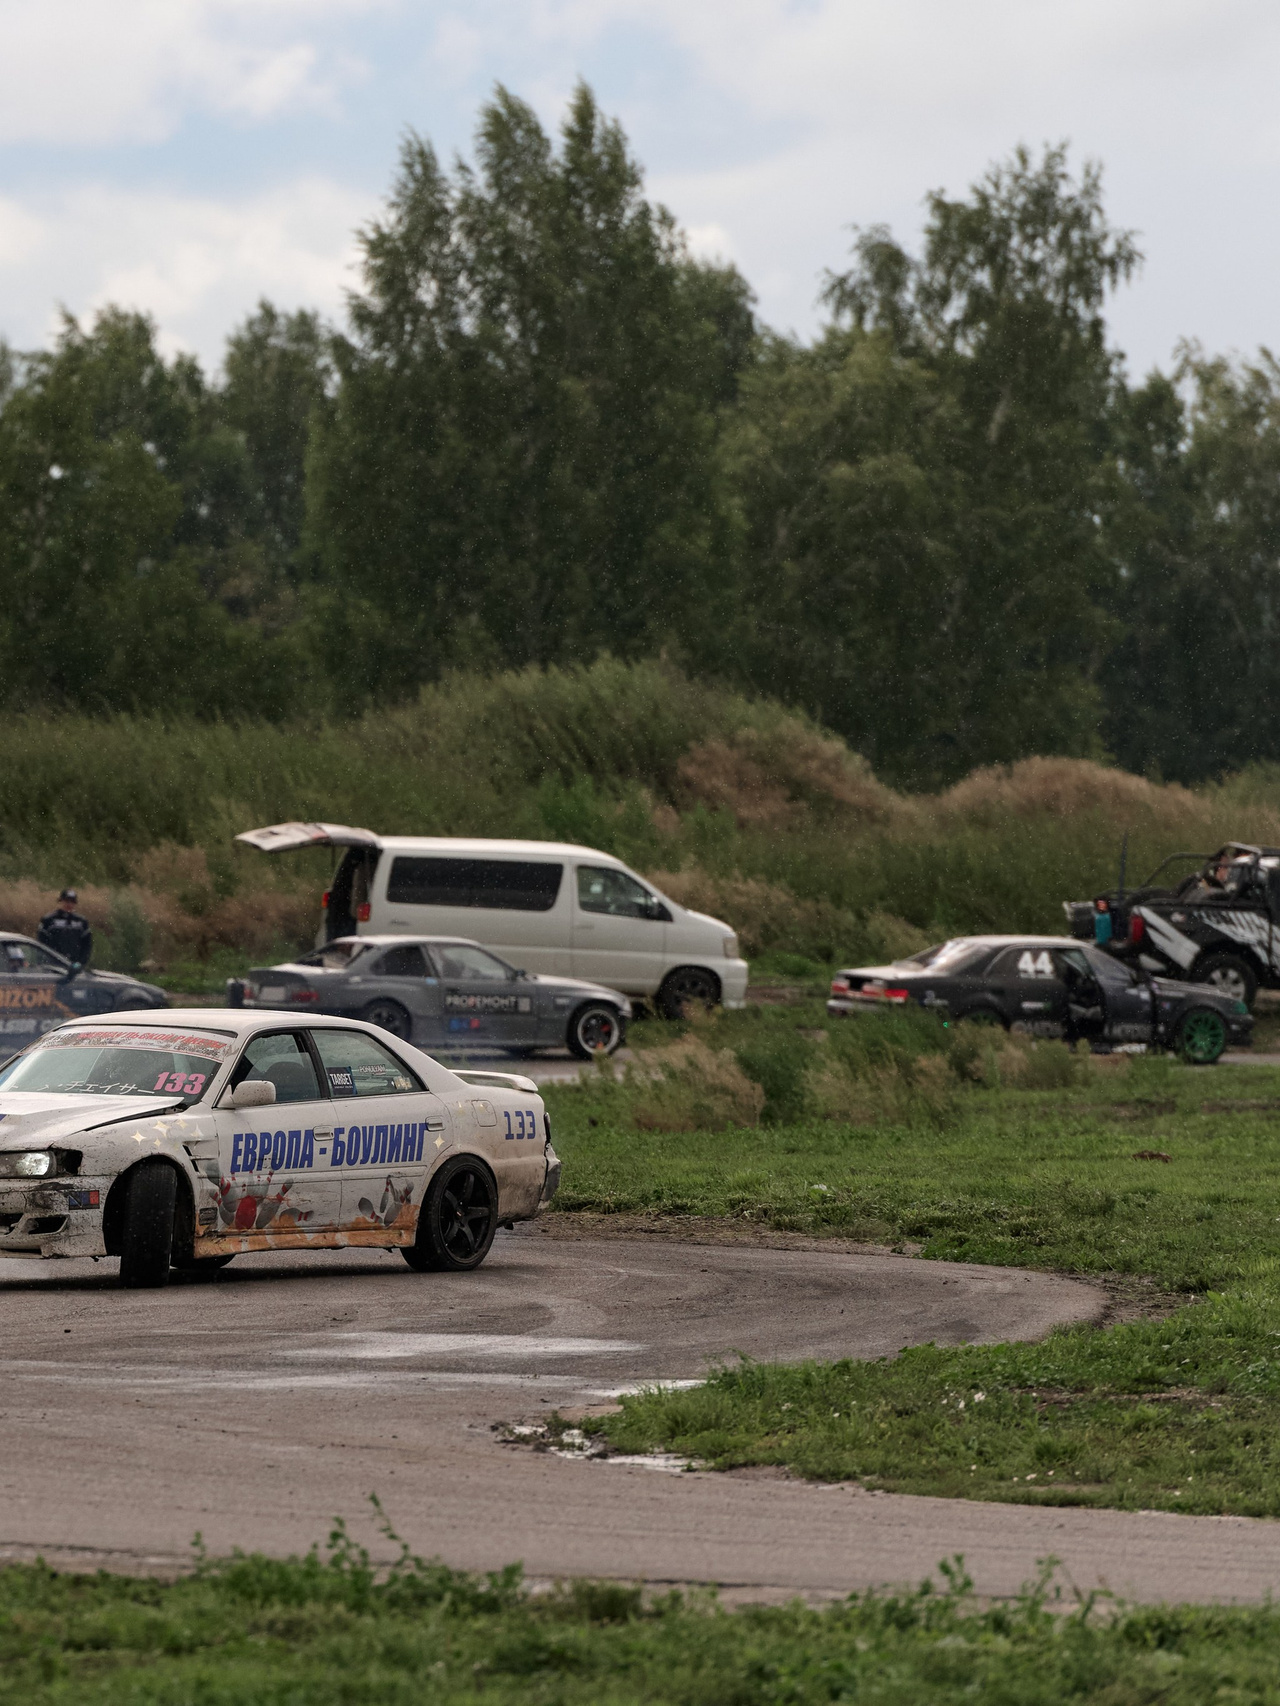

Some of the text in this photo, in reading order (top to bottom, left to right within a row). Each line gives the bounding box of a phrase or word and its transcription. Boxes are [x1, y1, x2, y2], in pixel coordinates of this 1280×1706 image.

[1018, 951, 1053, 974] 44
[153, 1071, 206, 1095] 133
[330, 1073, 352, 1086] TARGET
[503, 1110, 536, 1140] 133
